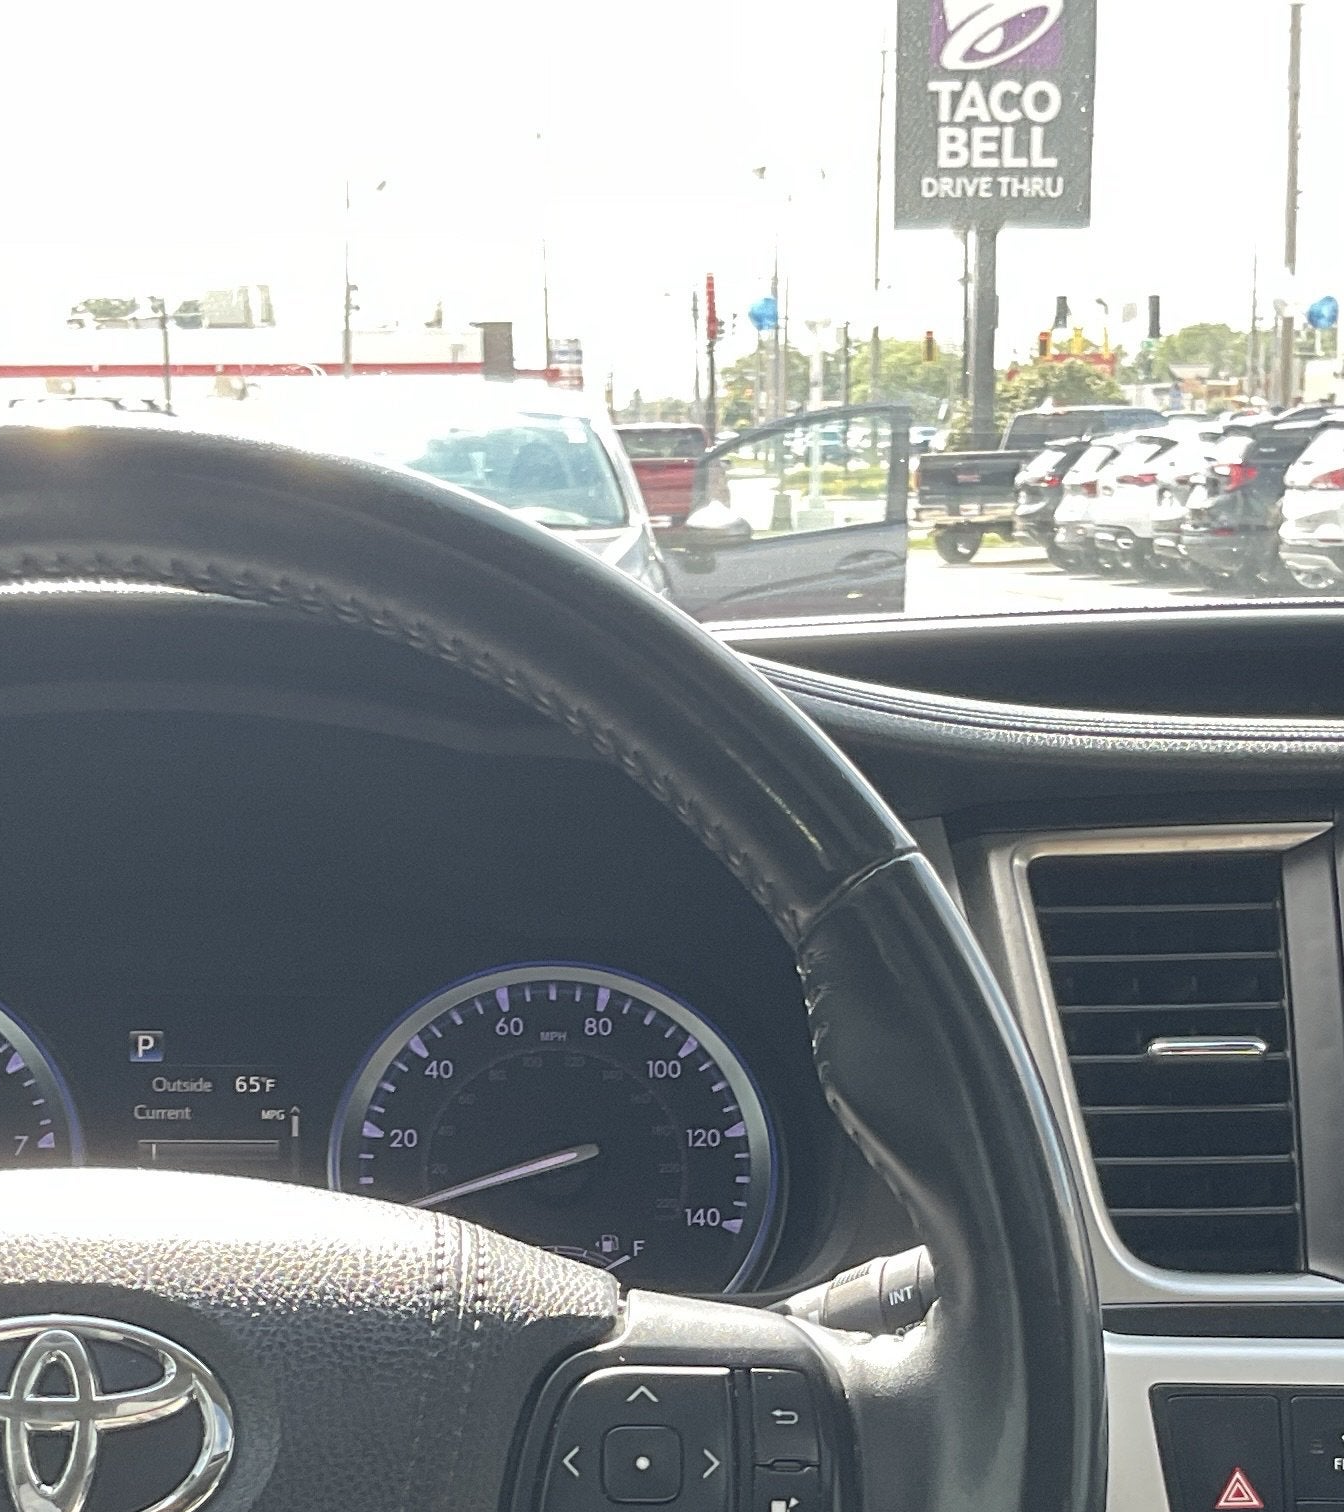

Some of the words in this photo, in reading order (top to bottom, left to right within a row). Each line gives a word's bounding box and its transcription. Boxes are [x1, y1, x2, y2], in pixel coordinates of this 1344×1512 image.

[927, 80, 1063, 123] TACO
[936, 125, 1058, 169] BELL
[920, 176, 993, 199] DRIVE
[997, 176, 1064, 199] THRU
[495, 1017, 524, 1037] 60
[583, 1016, 613, 1037] 80
[137, 1034, 155, 1058] P
[423, 1060, 454, 1079] 40
[645, 1059, 682, 1079] 100
[151, 1076, 214, 1093] Outside
[133, 1104, 193, 1120] Current
[13, 1135, 29, 1156] 7
[389, 1128, 418, 1148] 20
[685, 1128, 721, 1148] 120
[685, 1207, 721, 1227] 140
[633, 1240, 646, 1257] F
[888, 1284, 914, 1306] INT
